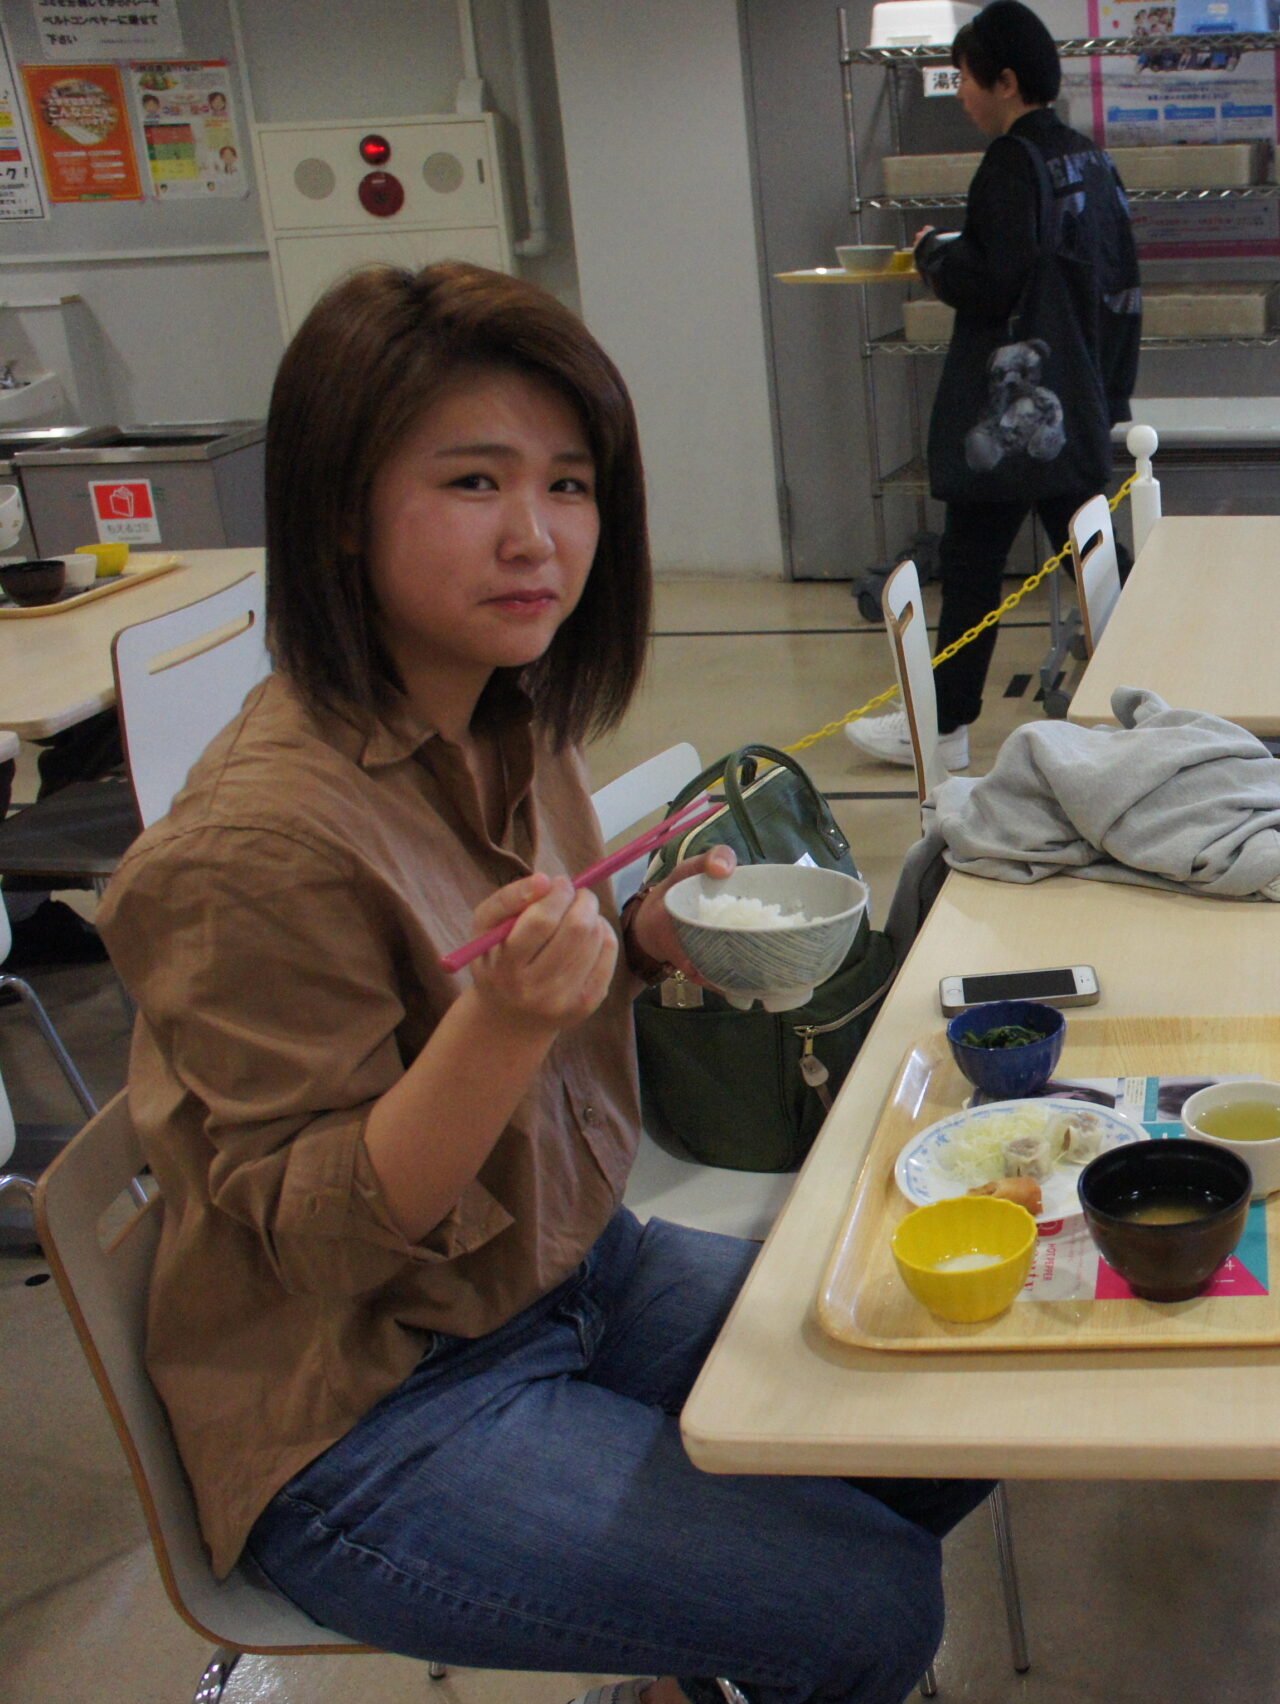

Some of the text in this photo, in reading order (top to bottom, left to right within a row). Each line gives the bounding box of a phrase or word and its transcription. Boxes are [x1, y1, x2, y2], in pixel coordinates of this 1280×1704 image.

[46, 33, 78, 45] 下さい
[106, 522, 151, 535] もえるゴミ
[1042, 1243, 1057, 1281] HOT PEPPER
